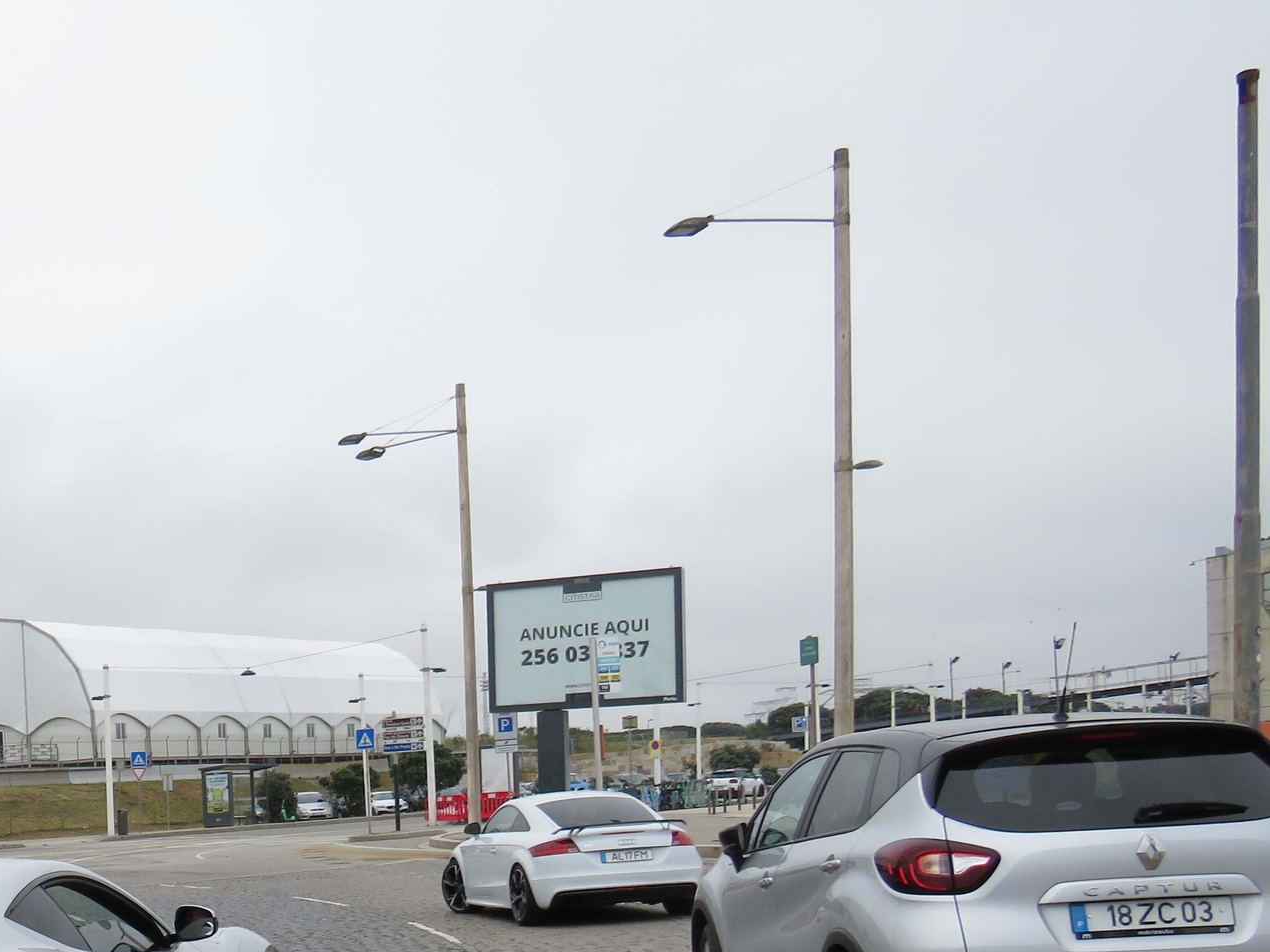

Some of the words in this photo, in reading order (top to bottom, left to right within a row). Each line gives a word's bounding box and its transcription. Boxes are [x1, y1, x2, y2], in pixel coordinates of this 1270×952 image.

[519, 622, 599, 641] ANUNCIE
[604, 618, 649, 636] AQUI
[521, 647, 559, 666] 256
[501, 719, 510, 731] P
[1083, 881, 1223, 897] CAPTUR
